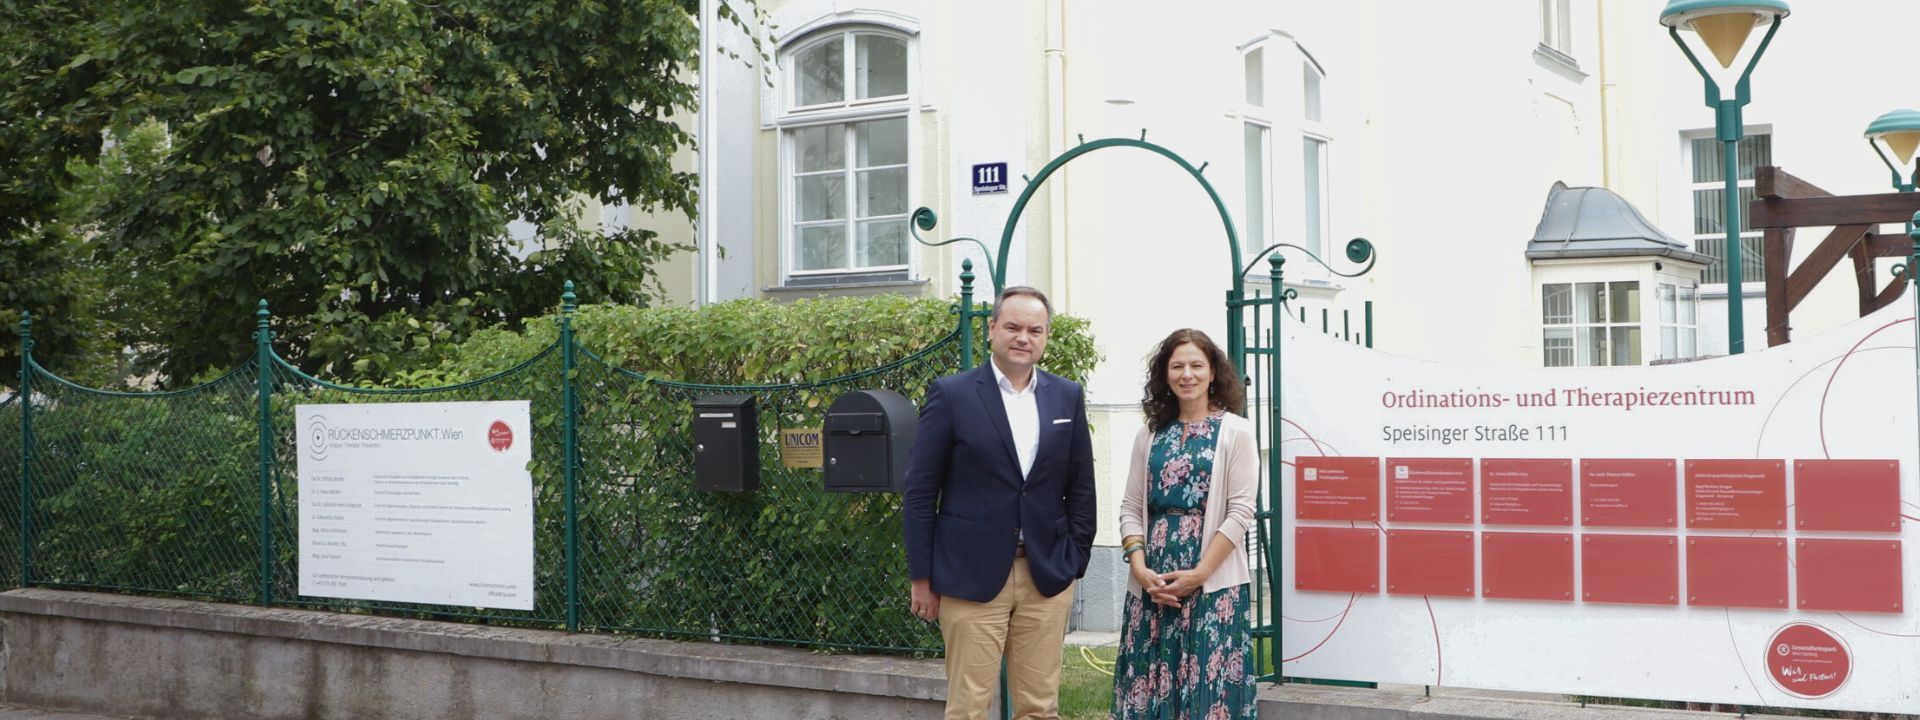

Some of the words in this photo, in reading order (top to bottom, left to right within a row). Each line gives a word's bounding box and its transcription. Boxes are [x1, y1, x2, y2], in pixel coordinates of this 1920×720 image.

[978, 166, 1000, 184] 111
[1382, 389, 1510, 408] Ordinations-
[1516, 388, 1557, 407] und
[1562, 387, 1756, 411] Therapiezentrum
[785, 433, 819, 446] UNICOM
[1383, 425, 1469, 445] Speisinger
[1474, 424, 1530, 441] Straße
[1536, 425, 1568, 441] 111
